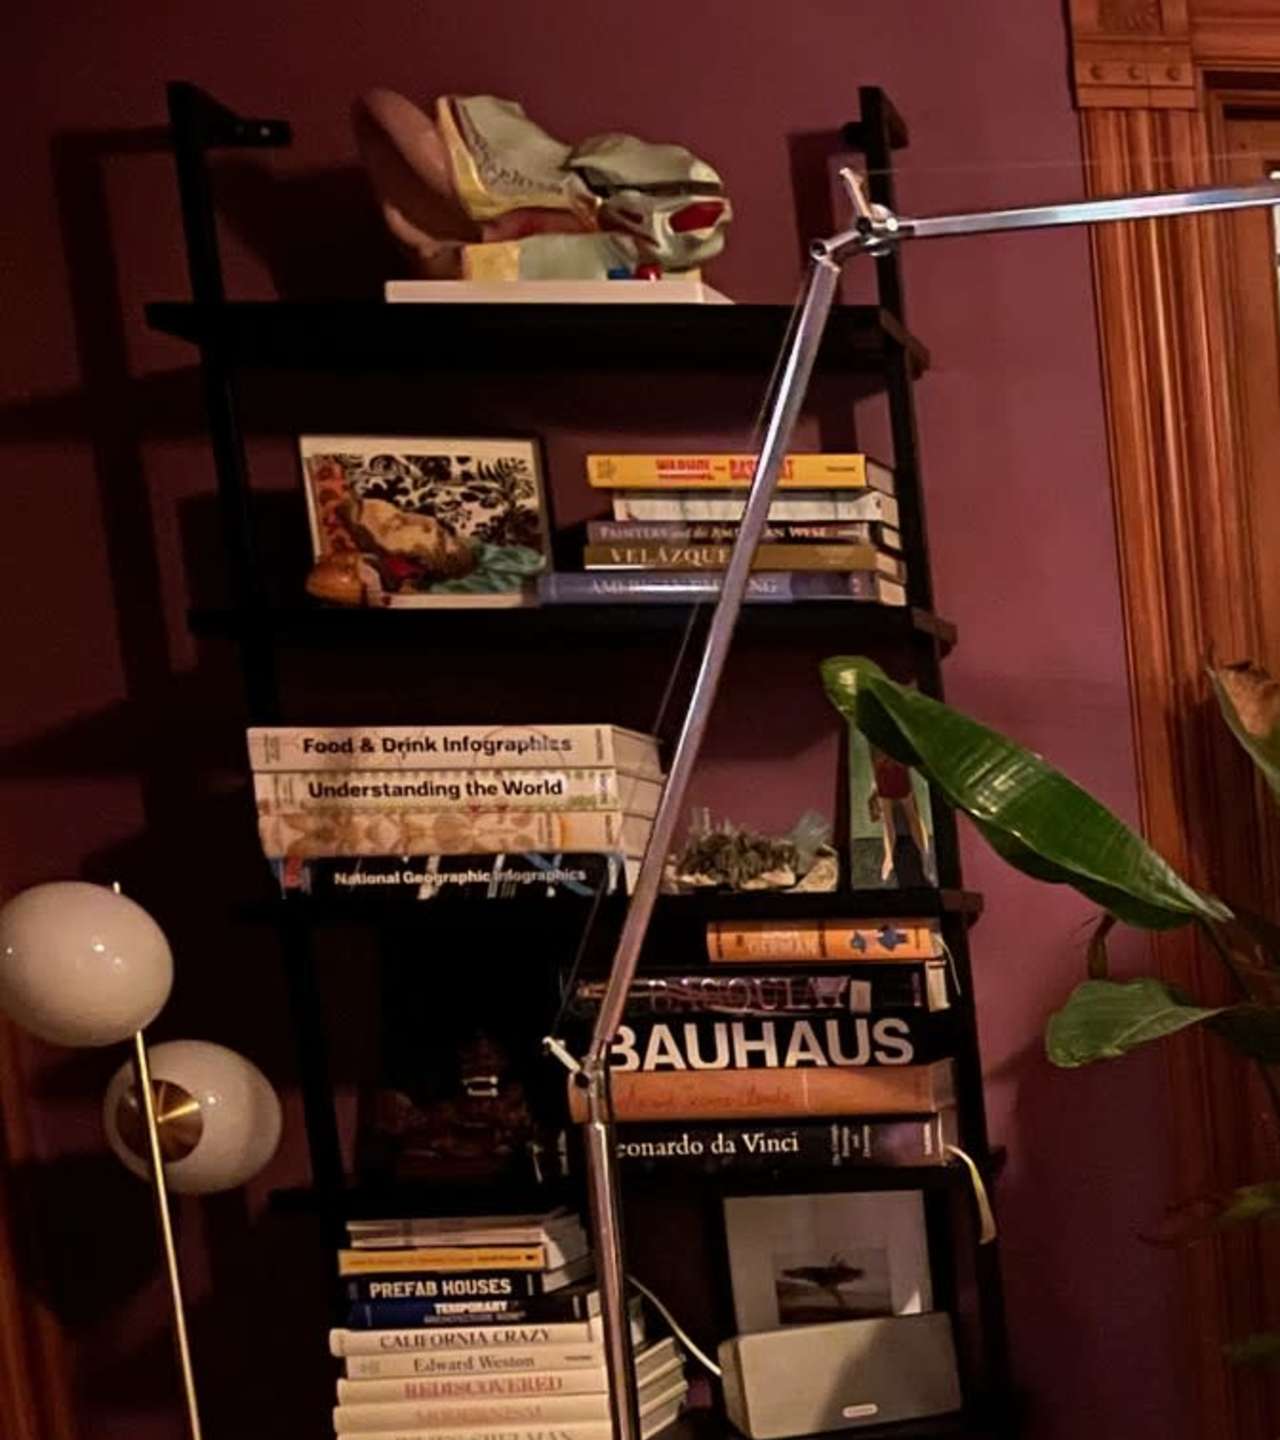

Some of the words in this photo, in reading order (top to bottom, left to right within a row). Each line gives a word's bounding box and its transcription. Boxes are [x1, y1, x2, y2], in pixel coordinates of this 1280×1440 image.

[609, 545, 728, 565] VELÁZQUE
[302, 737, 355, 754] Food
[360, 737, 375, 752] &
[382, 736, 438, 753] Drink
[443, 735, 572, 757] Infographics
[308, 781, 461, 801] Understanding
[466, 780, 498, 797] the
[502, 779, 563, 796] World
[334, 871, 400, 886] National
[403, 869, 490, 887] Geographic
[492, 867, 587, 884] Infographics
[609, 1017, 915, 1072] BAUHAUS
[616, 1133, 703, 1159] eonardo
[711, 1134, 737, 1155] da
[741, 1131, 800, 1155] Vinci
[369, 1280, 438, 1299] PREFAB
[442, 1278, 512, 1296] HOUSES
[380, 1331, 488, 1350] CALIFORNIA
[493, 1327, 550, 1344] CRAZY
[413, 1355, 474, 1373] Edward
[479, 1354, 535, 1370] Weston
[403, 1376, 563, 1400] REDISCOVERED
